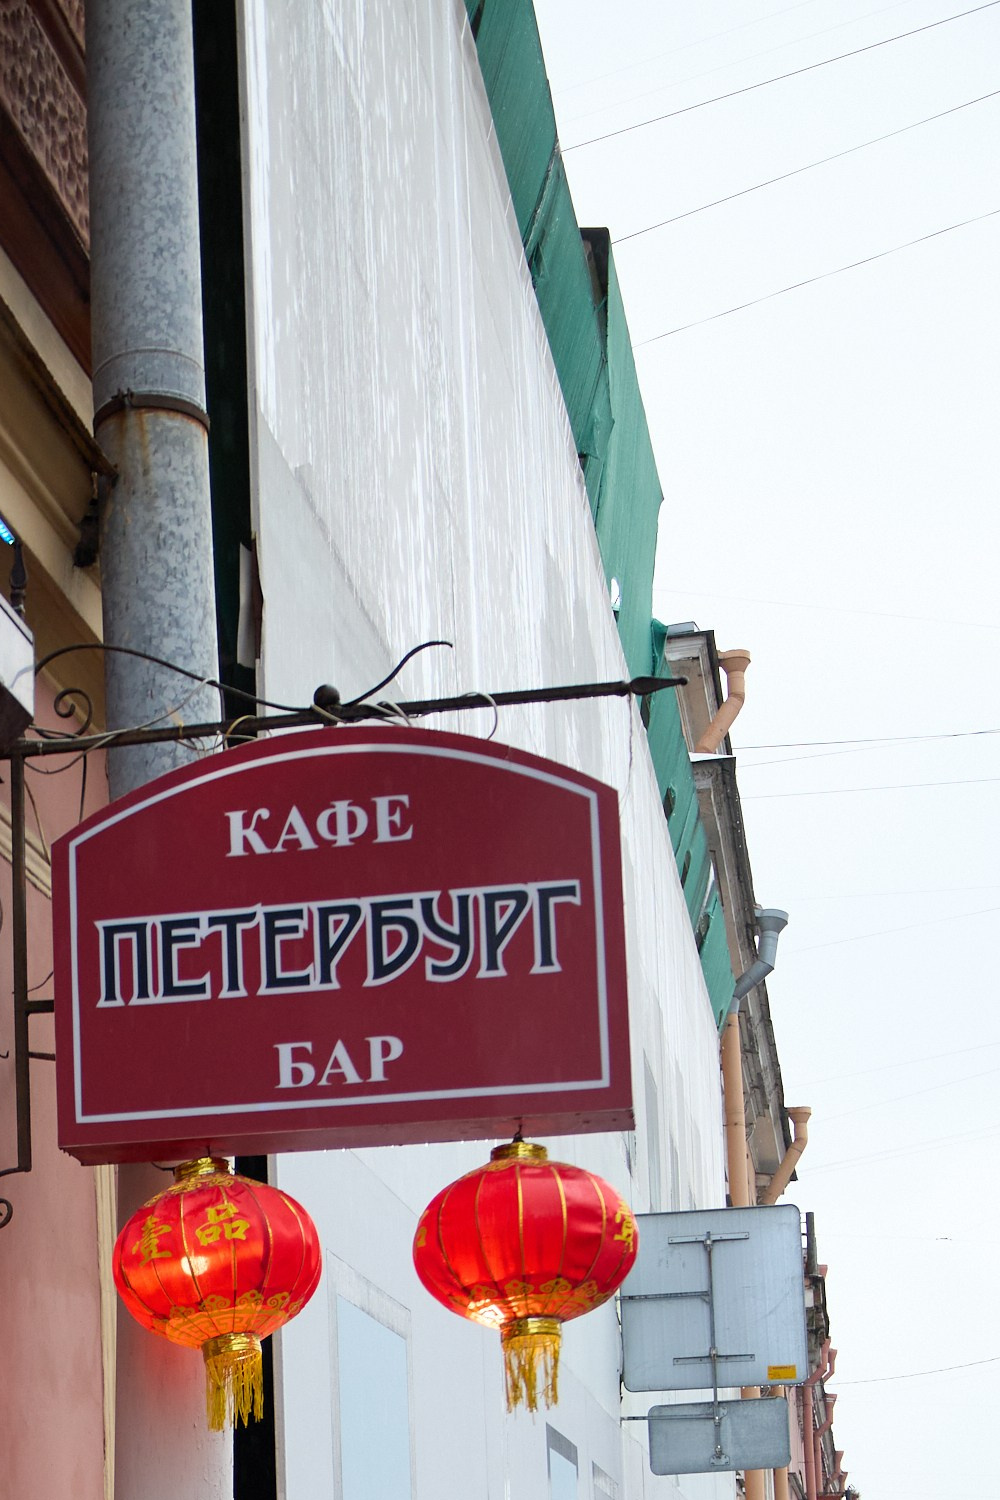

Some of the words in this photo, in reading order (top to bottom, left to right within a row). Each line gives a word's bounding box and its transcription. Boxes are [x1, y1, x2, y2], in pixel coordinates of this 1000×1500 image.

[225, 794, 415, 858] КАФЕ
[93, 879, 582, 1010] ПЕТЕРБУРГ
[273, 1034, 405, 1090] БАР
